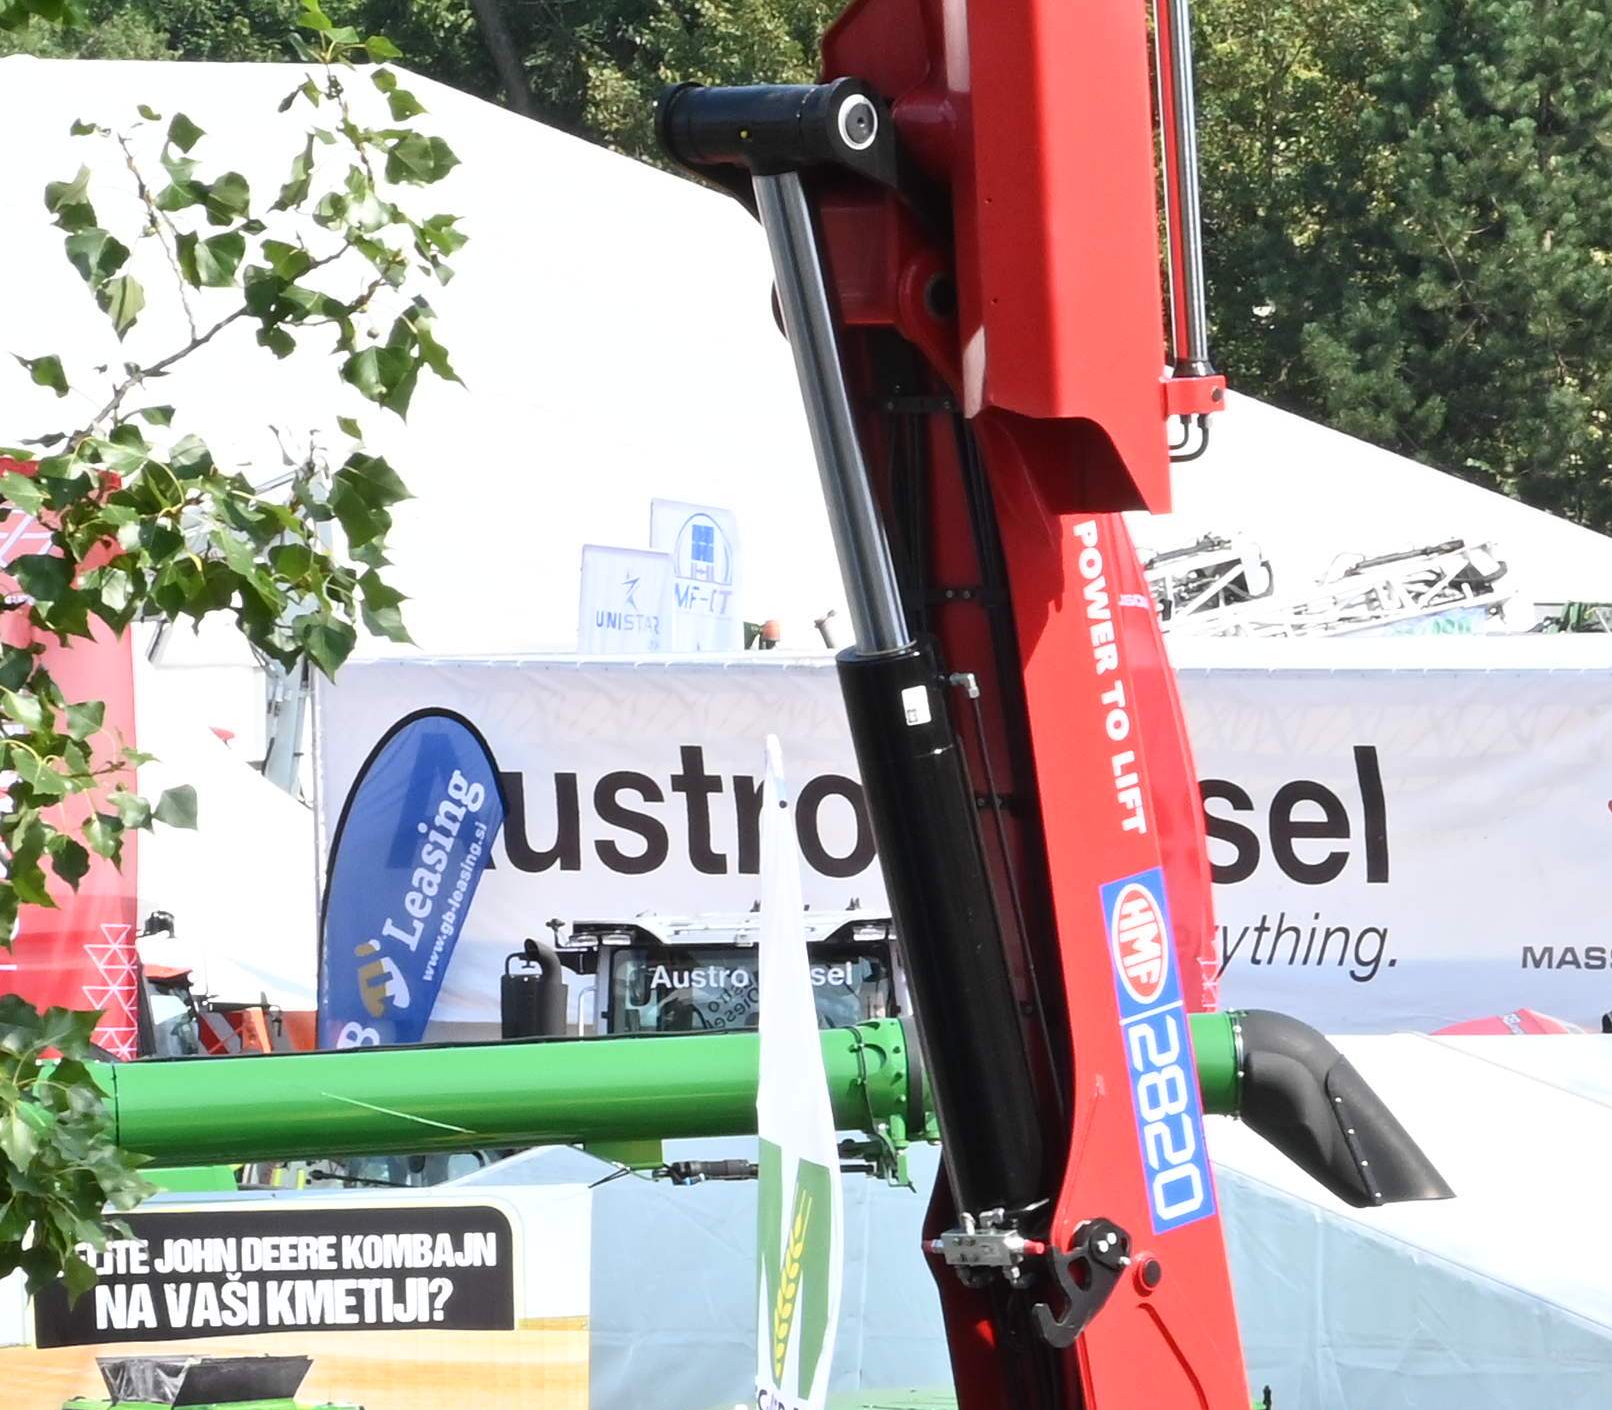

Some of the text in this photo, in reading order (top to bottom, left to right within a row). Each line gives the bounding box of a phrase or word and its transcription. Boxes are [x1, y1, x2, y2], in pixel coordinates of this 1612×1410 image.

[1072, 523, 1148, 835] POWER TO LIFT
[381, 768, 486, 953] Leasing
[1198, 745, 1389, 885] sel
[421, 821, 489, 983] www.gb-leasing.si
[1117, 900, 1162, 989] HMF
[1215, 911, 1398, 983] ything.
[650, 961, 853, 991] Austro sel
[1128, 1012, 1204, 1221] 2820
[95, 1273, 454, 1330] NA VAŠI KMETIJI?
[153, 1238, 237, 1274] JOHN
[241, 1234, 338, 1273] DEERE
[342, 1232, 497, 1272] KOMBAJN
